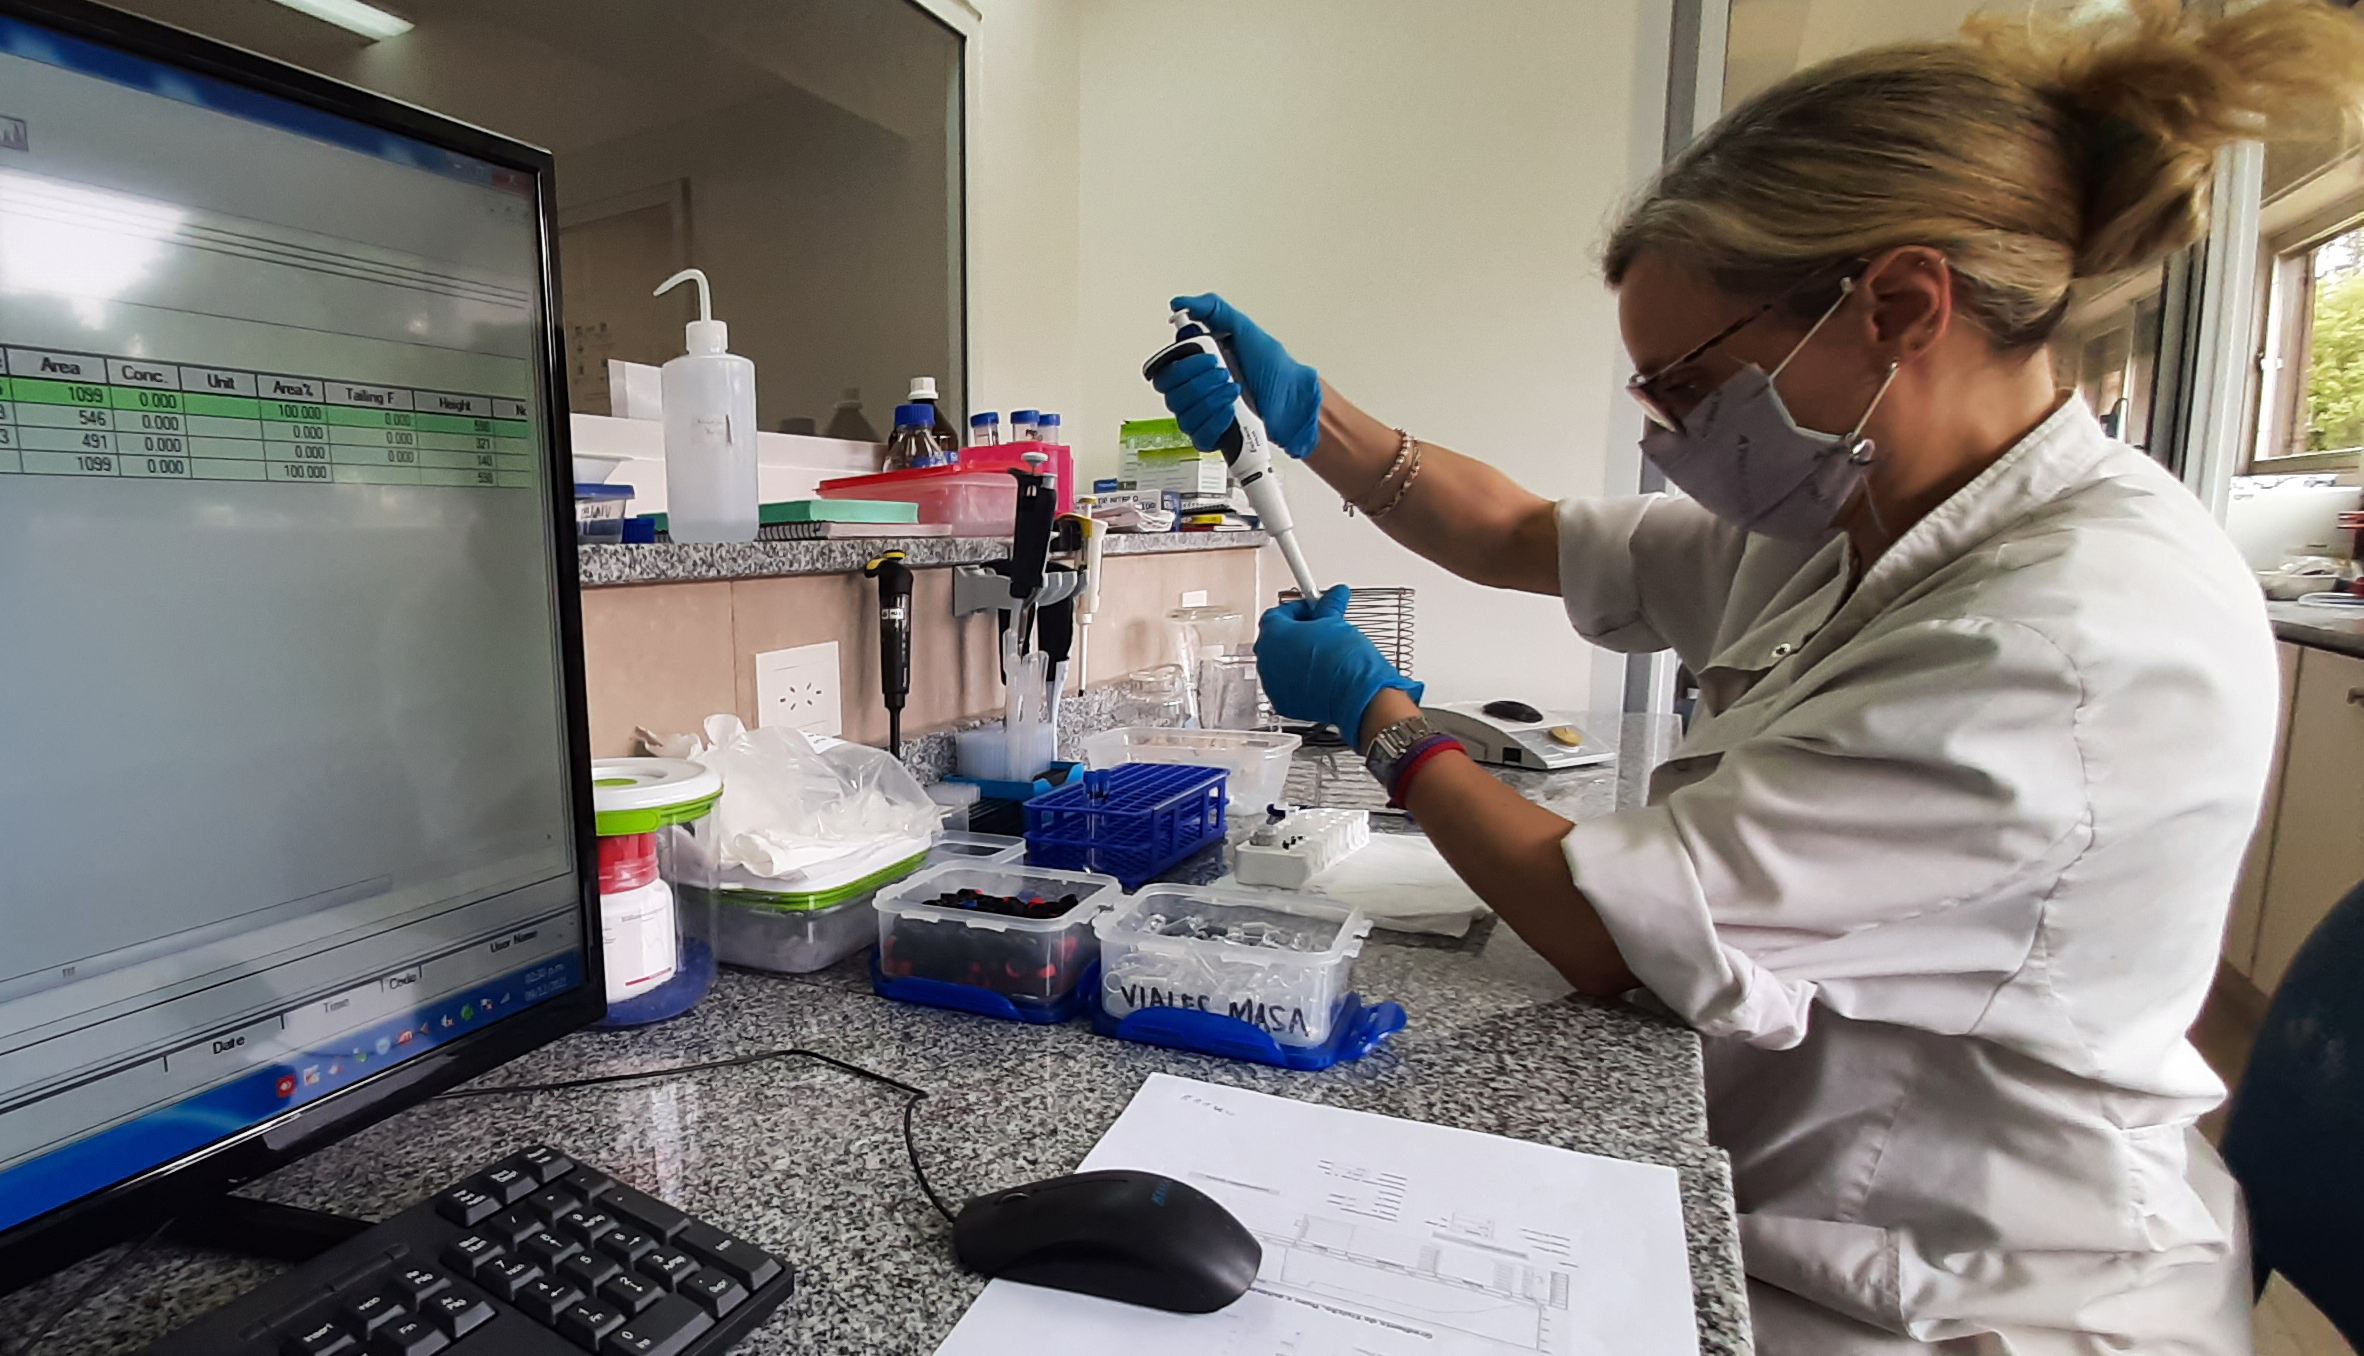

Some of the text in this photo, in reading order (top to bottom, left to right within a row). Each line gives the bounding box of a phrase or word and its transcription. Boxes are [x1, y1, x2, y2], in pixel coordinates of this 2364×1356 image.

[40, 356, 81, 375] Area
[122, 365, 168, 383] Conc.
[207, 373, 236, 390] Unit
[273, 380, 314, 397] Area%
[346, 387, 384, 405] Tailing
[439, 397, 471, 412] Height
[68, 386, 104, 404] 1099
[138, 392, 177, 409] 0.000
[79, 409, 107, 426] 546
[142, 414, 179, 431] 0.000
[293, 425, 324, 439] 0.000
[386, 431, 413, 445] 0.000
[82, 433, 108, 449] 491
[144, 437, 181, 452] 0.000
[294, 445, 325, 459] 0.000
[77, 456, 112, 472] 1099
[147, 458, 184, 474] 0.000
[212, 1035, 246, 1054] Date
[389, 973, 417, 990] Code
[1229, 999, 1311, 1038] MASA
